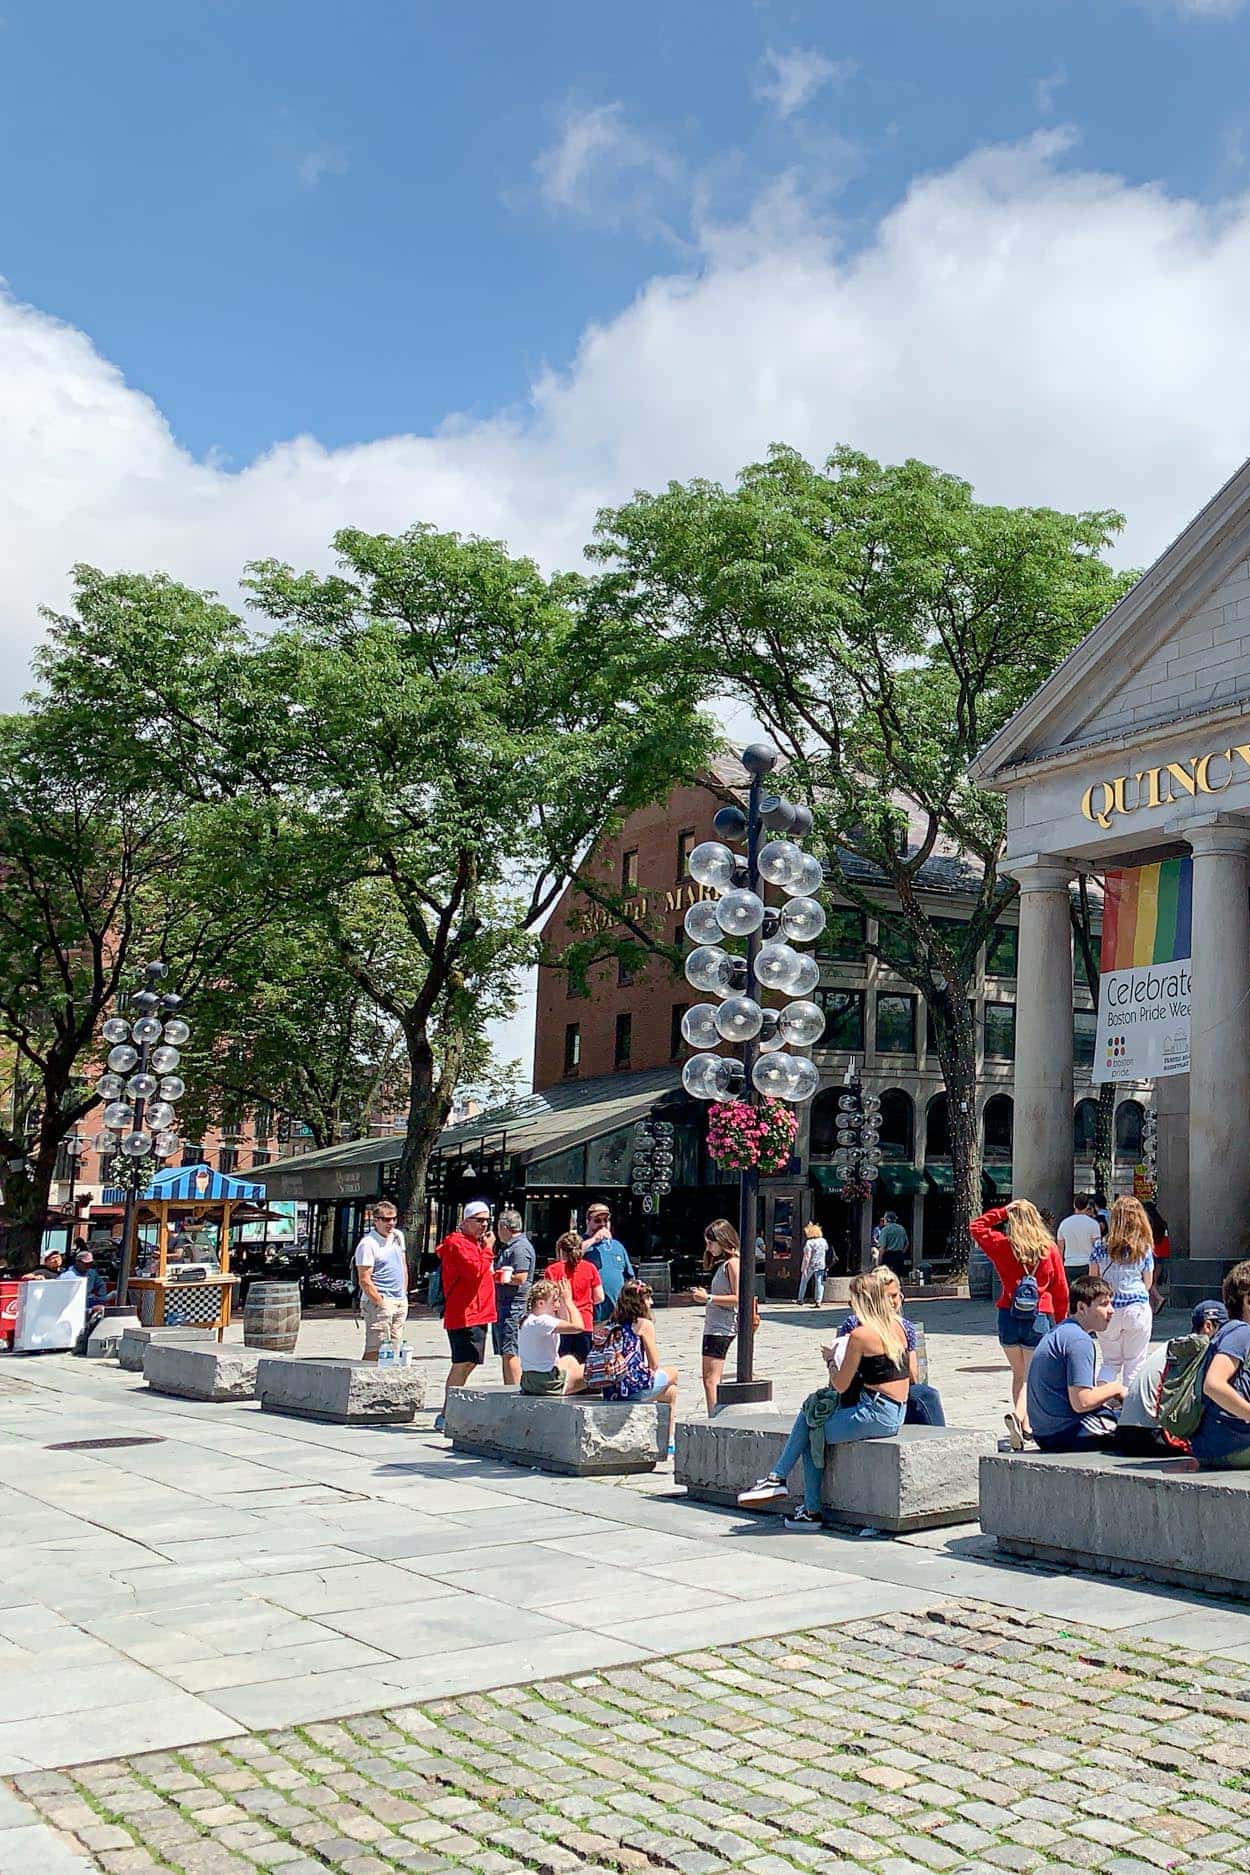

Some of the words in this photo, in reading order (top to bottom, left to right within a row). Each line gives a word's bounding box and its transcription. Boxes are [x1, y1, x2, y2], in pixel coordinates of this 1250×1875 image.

[1108, 1010, 1137, 1027] Boston
[1140, 1003, 1167, 1021] Pride
[1169, 1002, 1191, 1017] Wee
